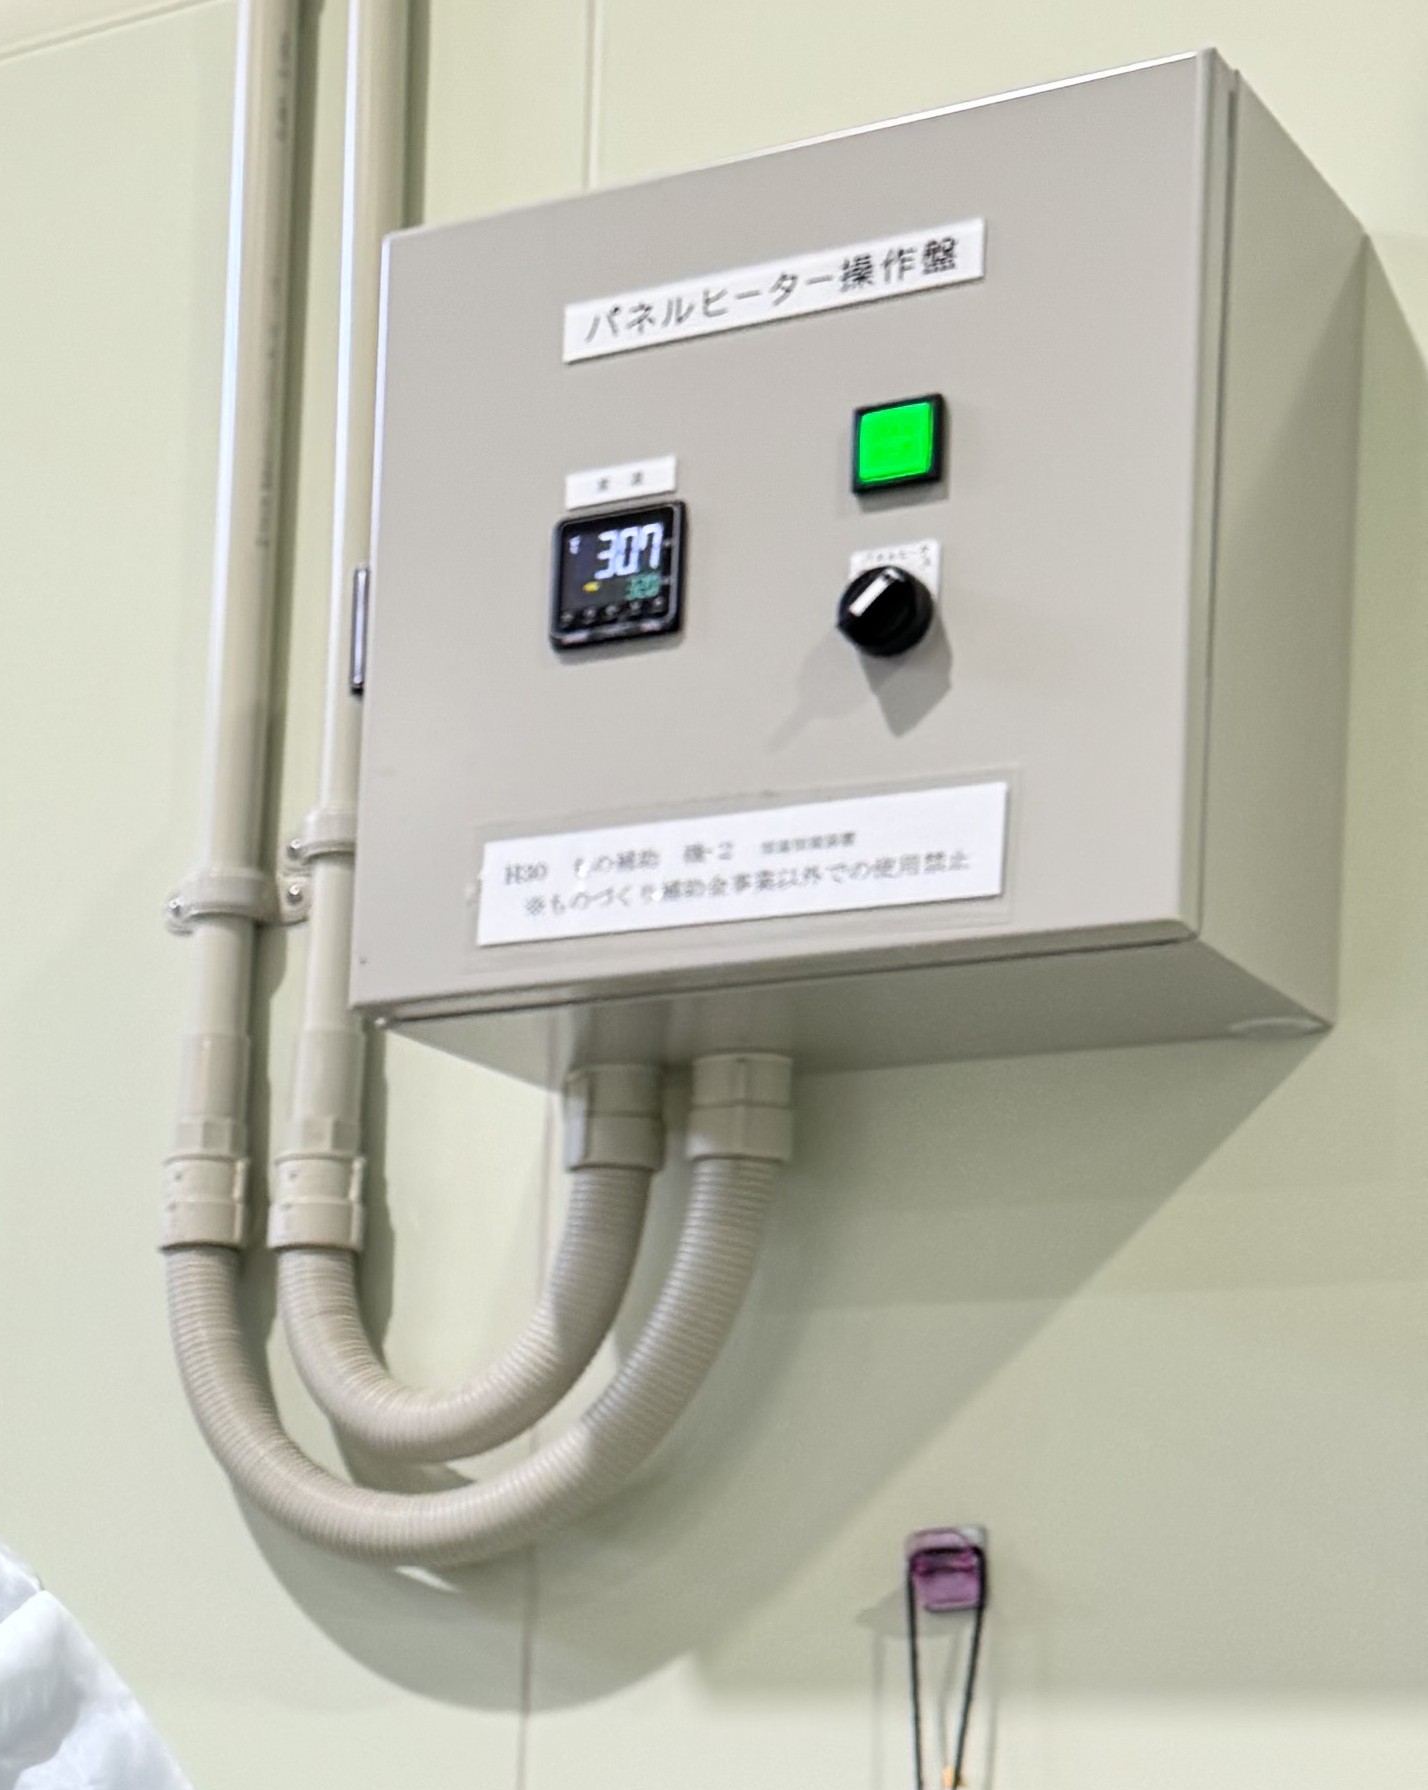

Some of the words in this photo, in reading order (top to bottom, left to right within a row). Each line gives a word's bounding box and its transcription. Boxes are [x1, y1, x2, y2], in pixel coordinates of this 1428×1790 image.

[585, 236, 959, 343] パネルヒーター操作盤
